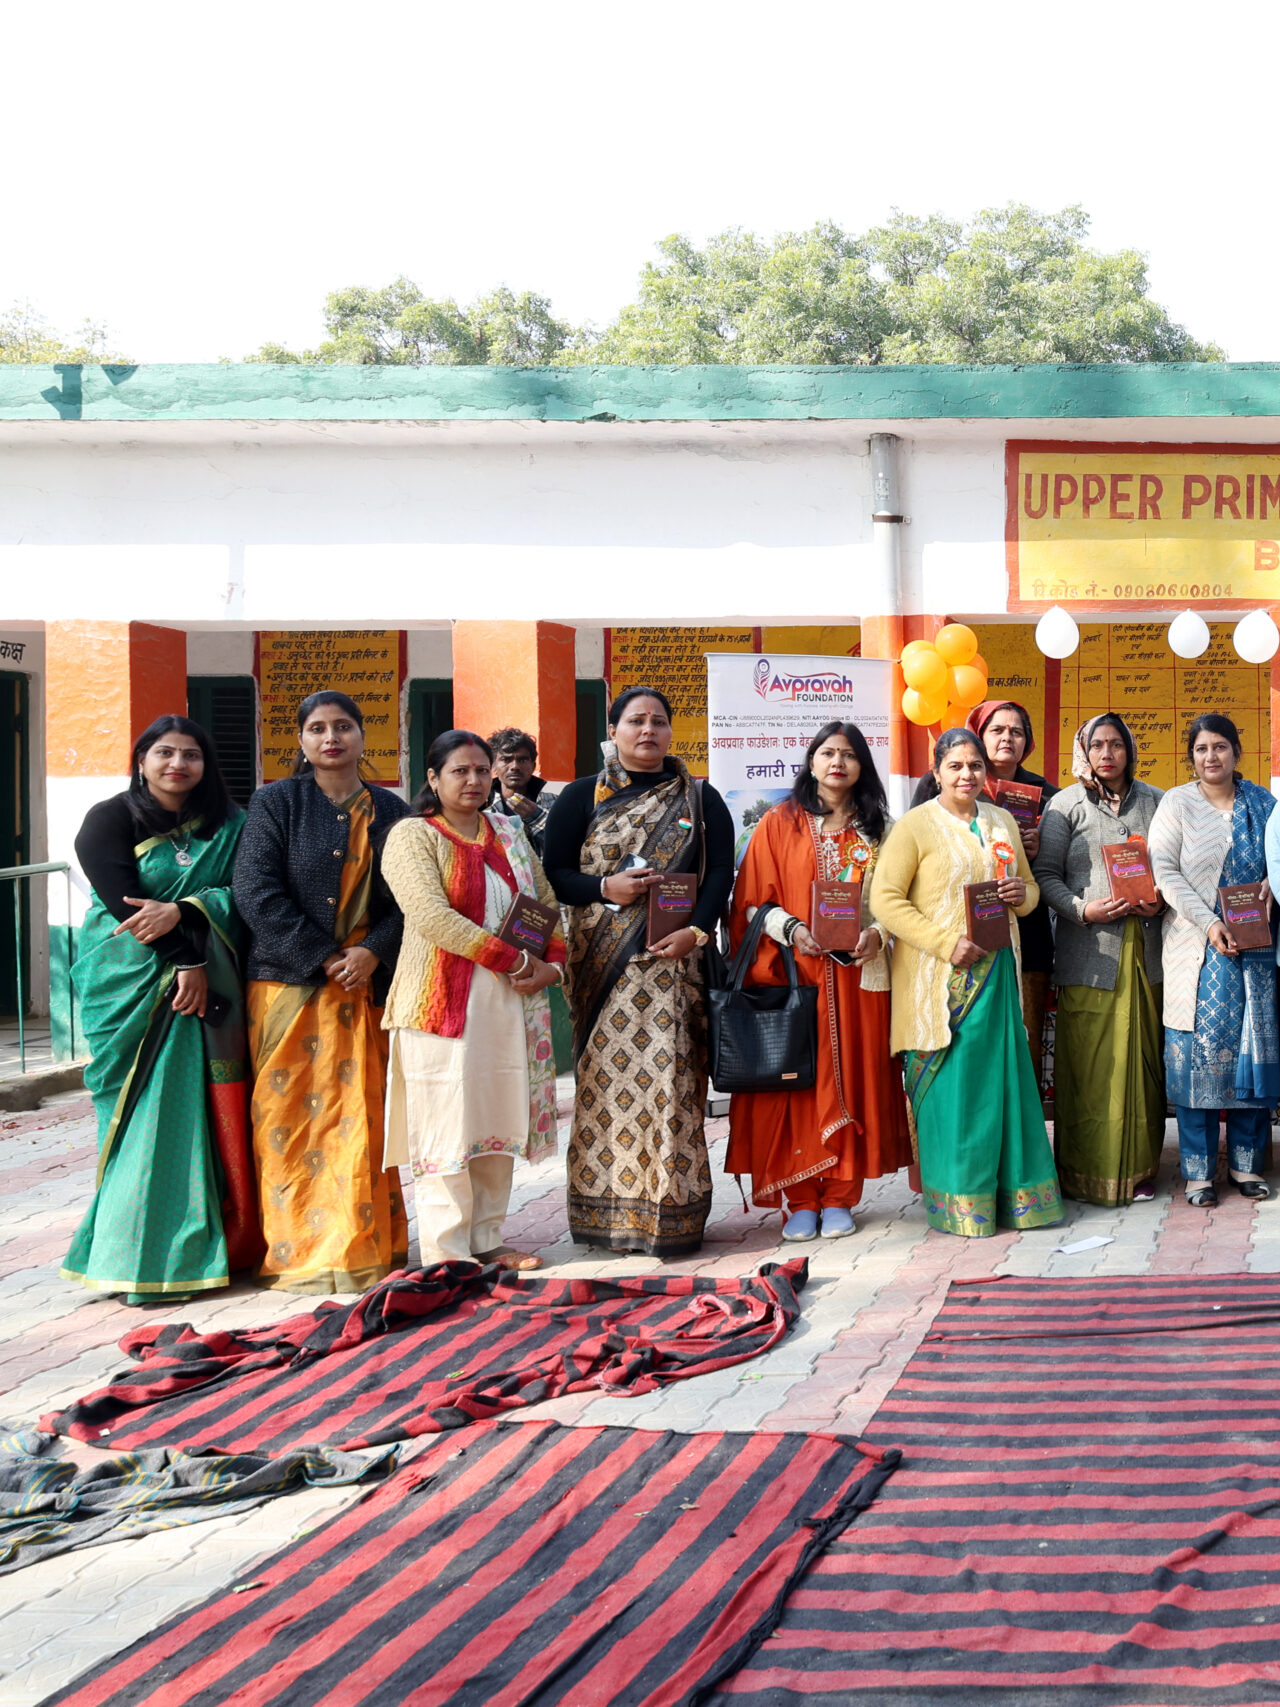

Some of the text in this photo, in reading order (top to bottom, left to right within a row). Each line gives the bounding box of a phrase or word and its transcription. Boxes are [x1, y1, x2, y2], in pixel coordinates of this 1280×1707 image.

[1023, 473, 1164, 520] UPPER
[769, 674, 854, 697] Avpravah
[796, 693, 854, 703] FOUNDATION
[711, 737, 745, 750] अवप्रवाह
[783, 737, 797, 749] एक
[746, 759, 785, 780] हमारी
